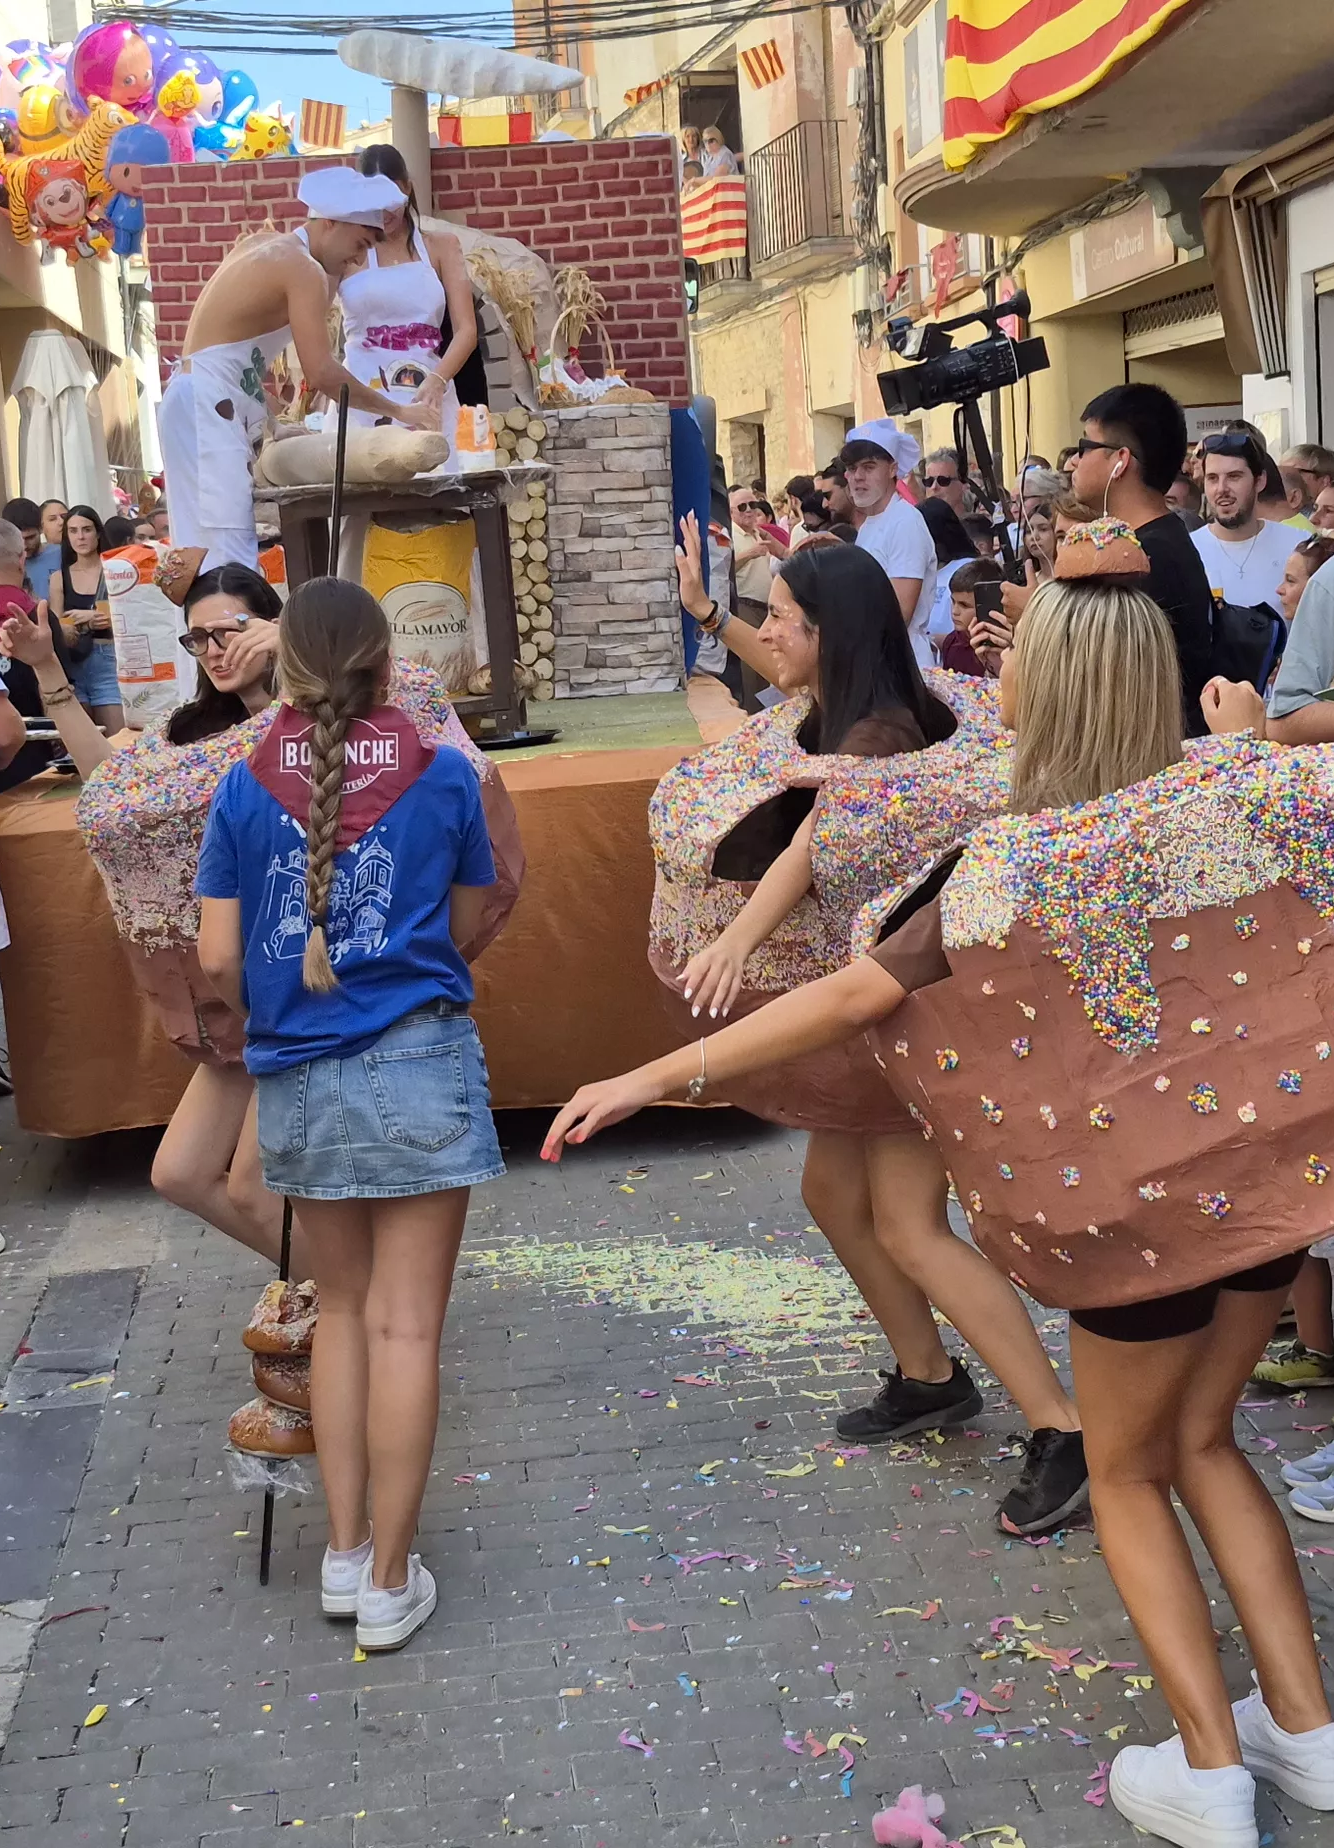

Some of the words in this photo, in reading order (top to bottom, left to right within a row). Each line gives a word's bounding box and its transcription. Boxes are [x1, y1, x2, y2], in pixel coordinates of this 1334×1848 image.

[1114, 226, 1146, 261] Cultural
[388, 618, 468, 637] ILLAMAYOR
[285, 739, 396, 767] BONCHE
